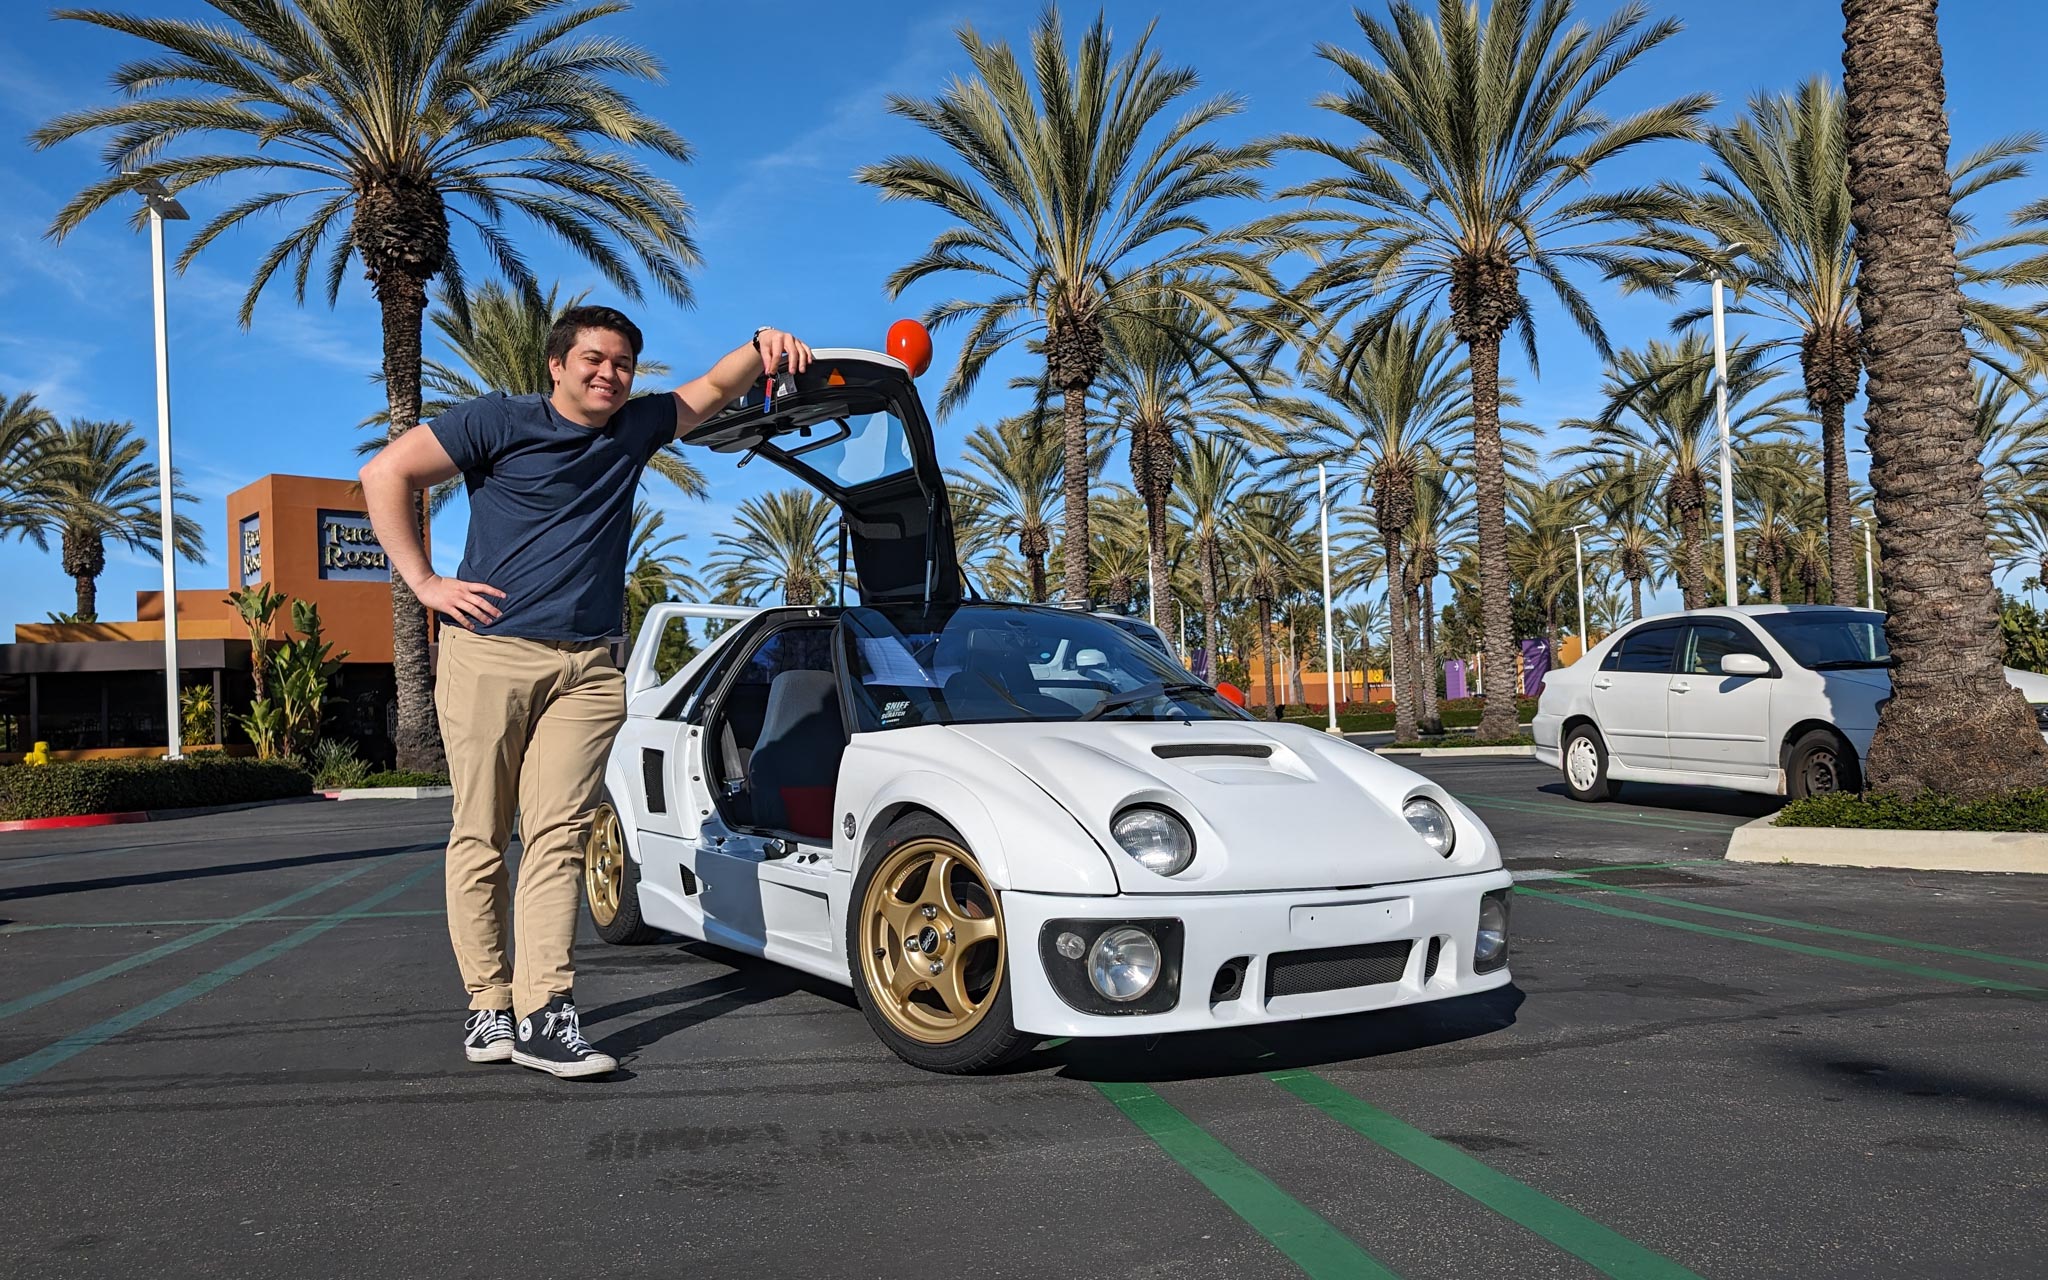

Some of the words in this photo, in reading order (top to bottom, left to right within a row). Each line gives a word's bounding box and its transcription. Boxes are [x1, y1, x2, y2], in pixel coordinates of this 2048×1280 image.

[324, 545, 386, 568] Rosa
[884, 701, 910, 711] SNIFF
[881, 711, 906, 720] SCRATCH
